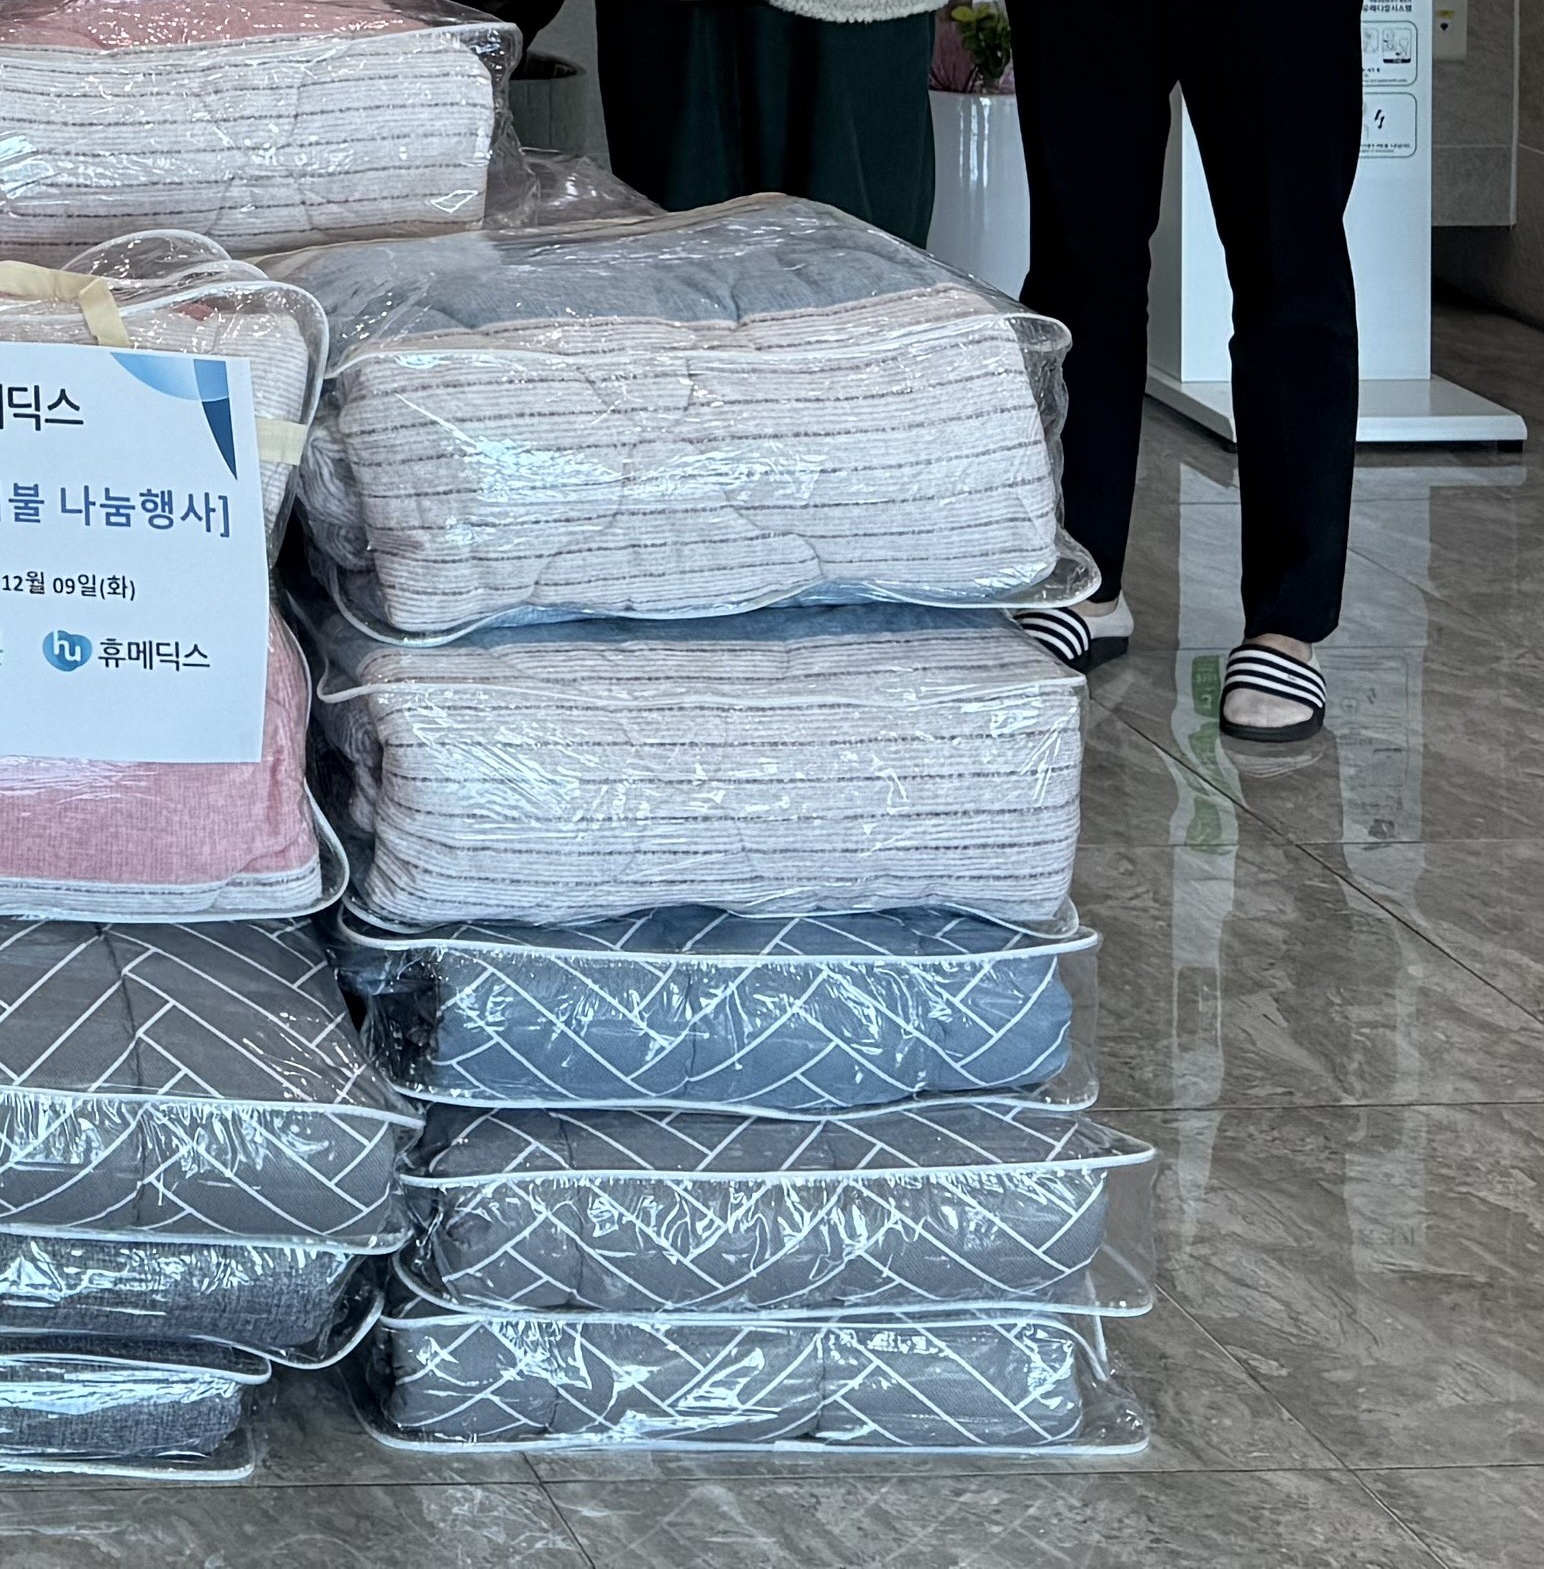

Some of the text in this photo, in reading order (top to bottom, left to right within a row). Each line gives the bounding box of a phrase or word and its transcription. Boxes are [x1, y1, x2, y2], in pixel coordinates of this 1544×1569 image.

[61, 485, 229, 537] 나눔행사]
[3, 571, 44, 594] 12월
[53, 575, 135, 601] 09일(화)
[98, 639, 210, 671] 휴메딕스
